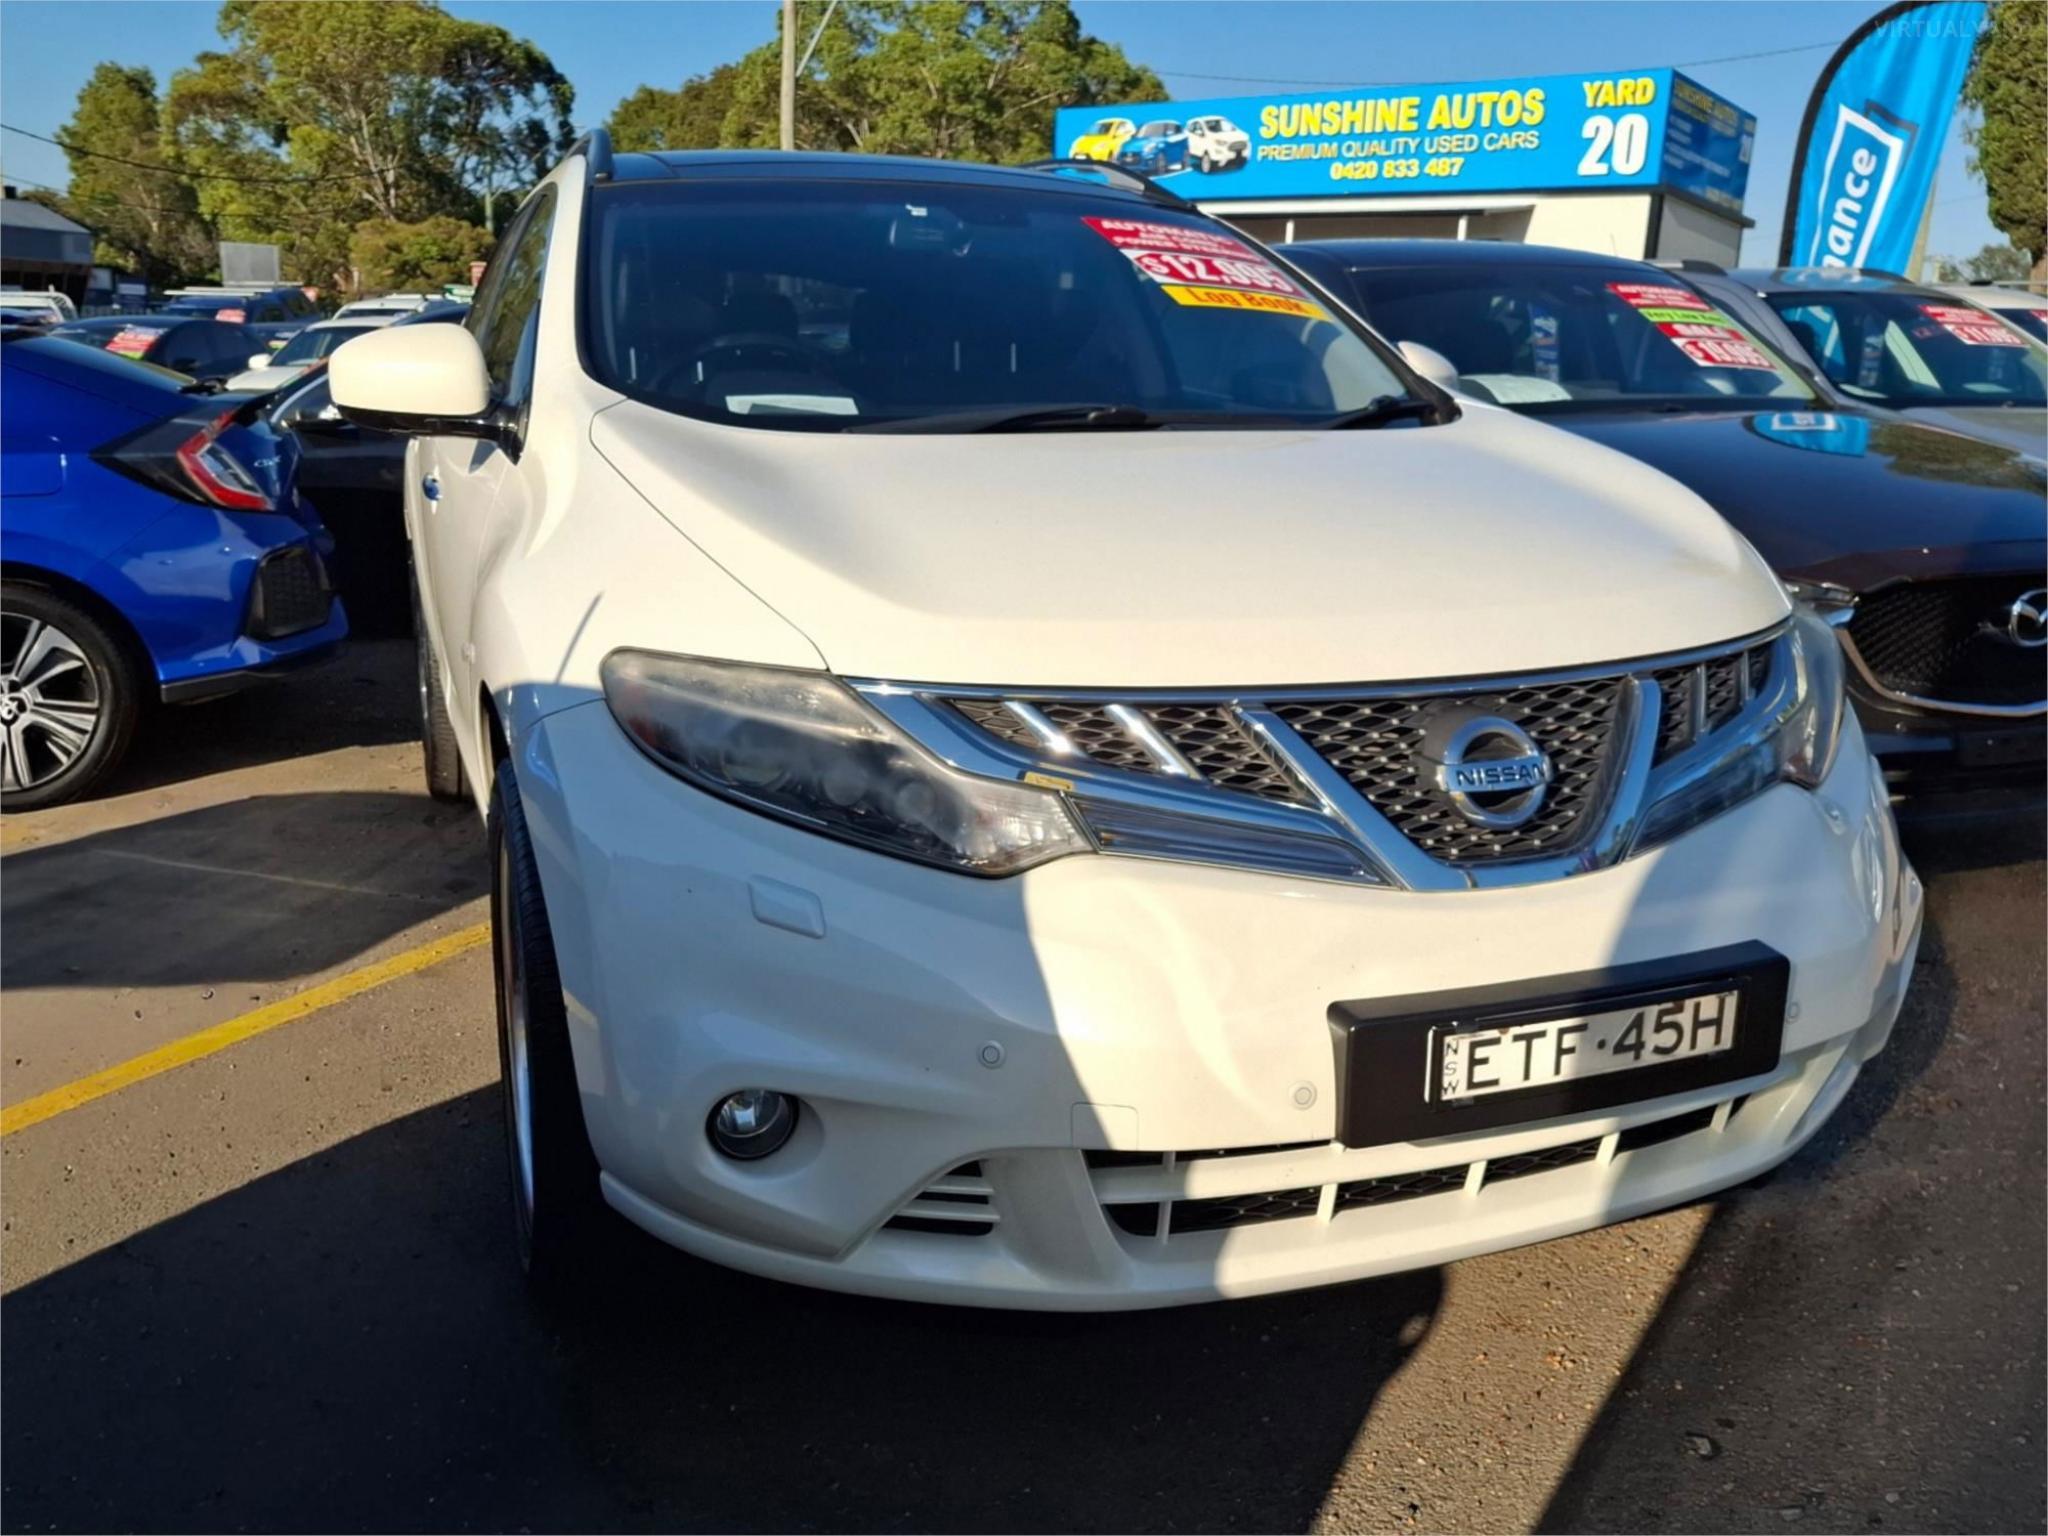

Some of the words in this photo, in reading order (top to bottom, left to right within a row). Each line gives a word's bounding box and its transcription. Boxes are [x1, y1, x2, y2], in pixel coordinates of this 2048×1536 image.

[1582, 77, 1655, 108] YARD
[1258, 97, 1421, 139] SUNSHINE
[1426, 88, 1545, 131] AUTOS
[1257, 142, 1339, 162] PREMIUM
[1342, 136, 1421, 158] QUALITY
[1424, 133, 1480, 154] USED
[1483, 130, 1540, 152] CARS
[1577, 113, 1649, 176] 20
[1330, 161, 1377, 181] 0420
[1382, 158, 1420, 179] 833
[1138, 252, 1295, 293] $12,995
[1186, 286, 1243, 308] Log
[1247, 292, 1308, 314] Book
[1455, 763, 1545, 787] NISSAN
[1441, 1039, 1459, 1097] NSW
